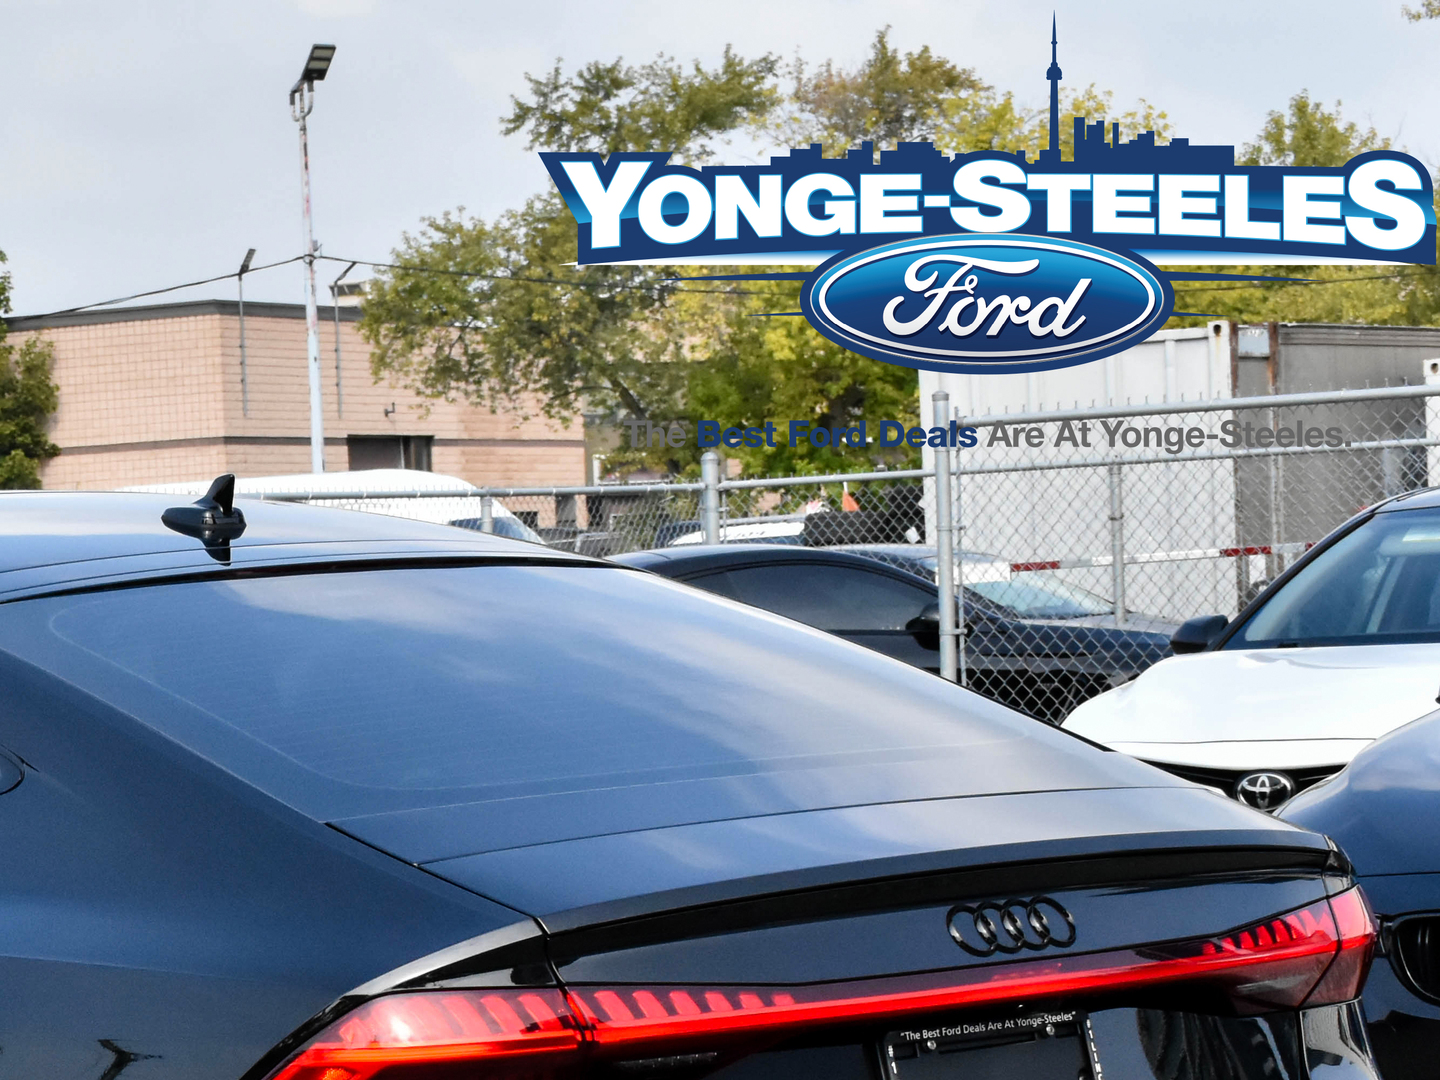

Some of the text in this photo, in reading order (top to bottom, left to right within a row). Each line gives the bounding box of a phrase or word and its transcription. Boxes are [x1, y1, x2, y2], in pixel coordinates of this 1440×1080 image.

[922, 1028, 941, 1039] Best
[942, 1025, 961, 1037] Ford
[963, 1022, 986, 1034] Deals
[987, 1021, 1003, 1031] Are
[1004, 1020, 1015, 1029] At
[887, 1045, 898, 1075] #1
